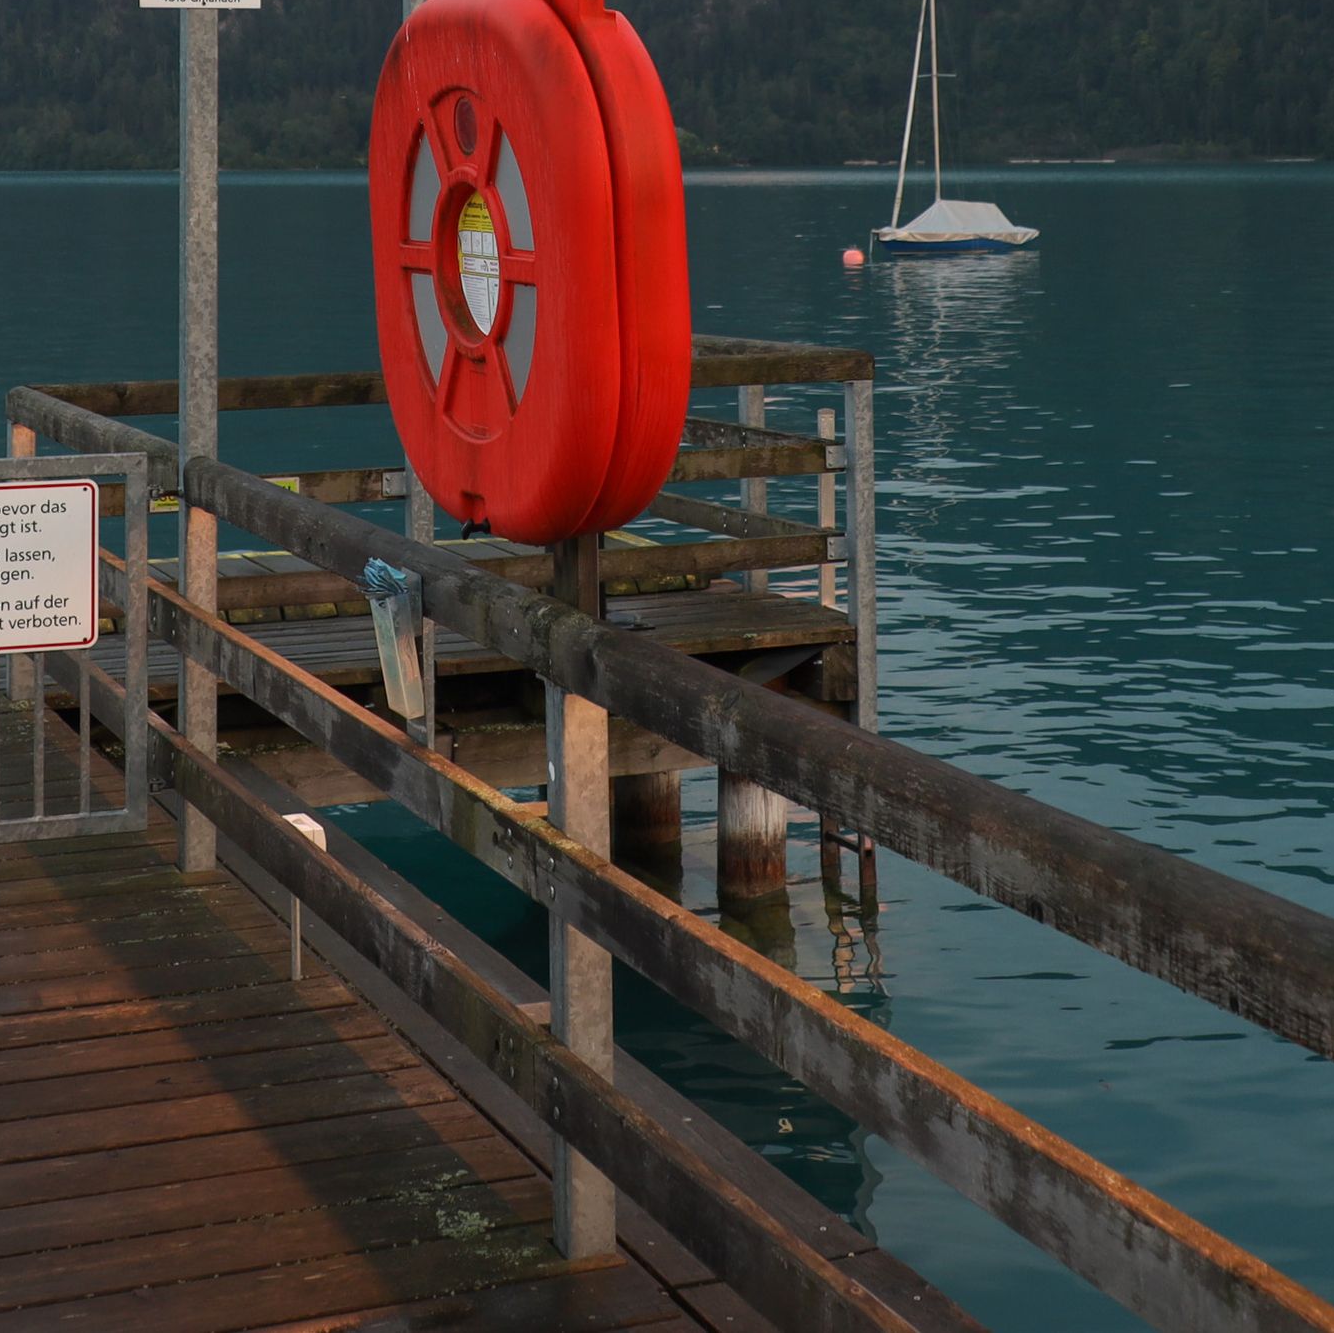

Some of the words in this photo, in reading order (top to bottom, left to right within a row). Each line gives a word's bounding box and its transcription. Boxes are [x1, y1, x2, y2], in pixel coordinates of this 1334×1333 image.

[40, 499, 67, 514] das
[20, 519, 42, 533] ist.
[4, 547, 56, 563] lassen,
[14, 595, 40, 611] auf
[43, 594, 69, 609] der
[8, 613, 82, 630] verboten.
